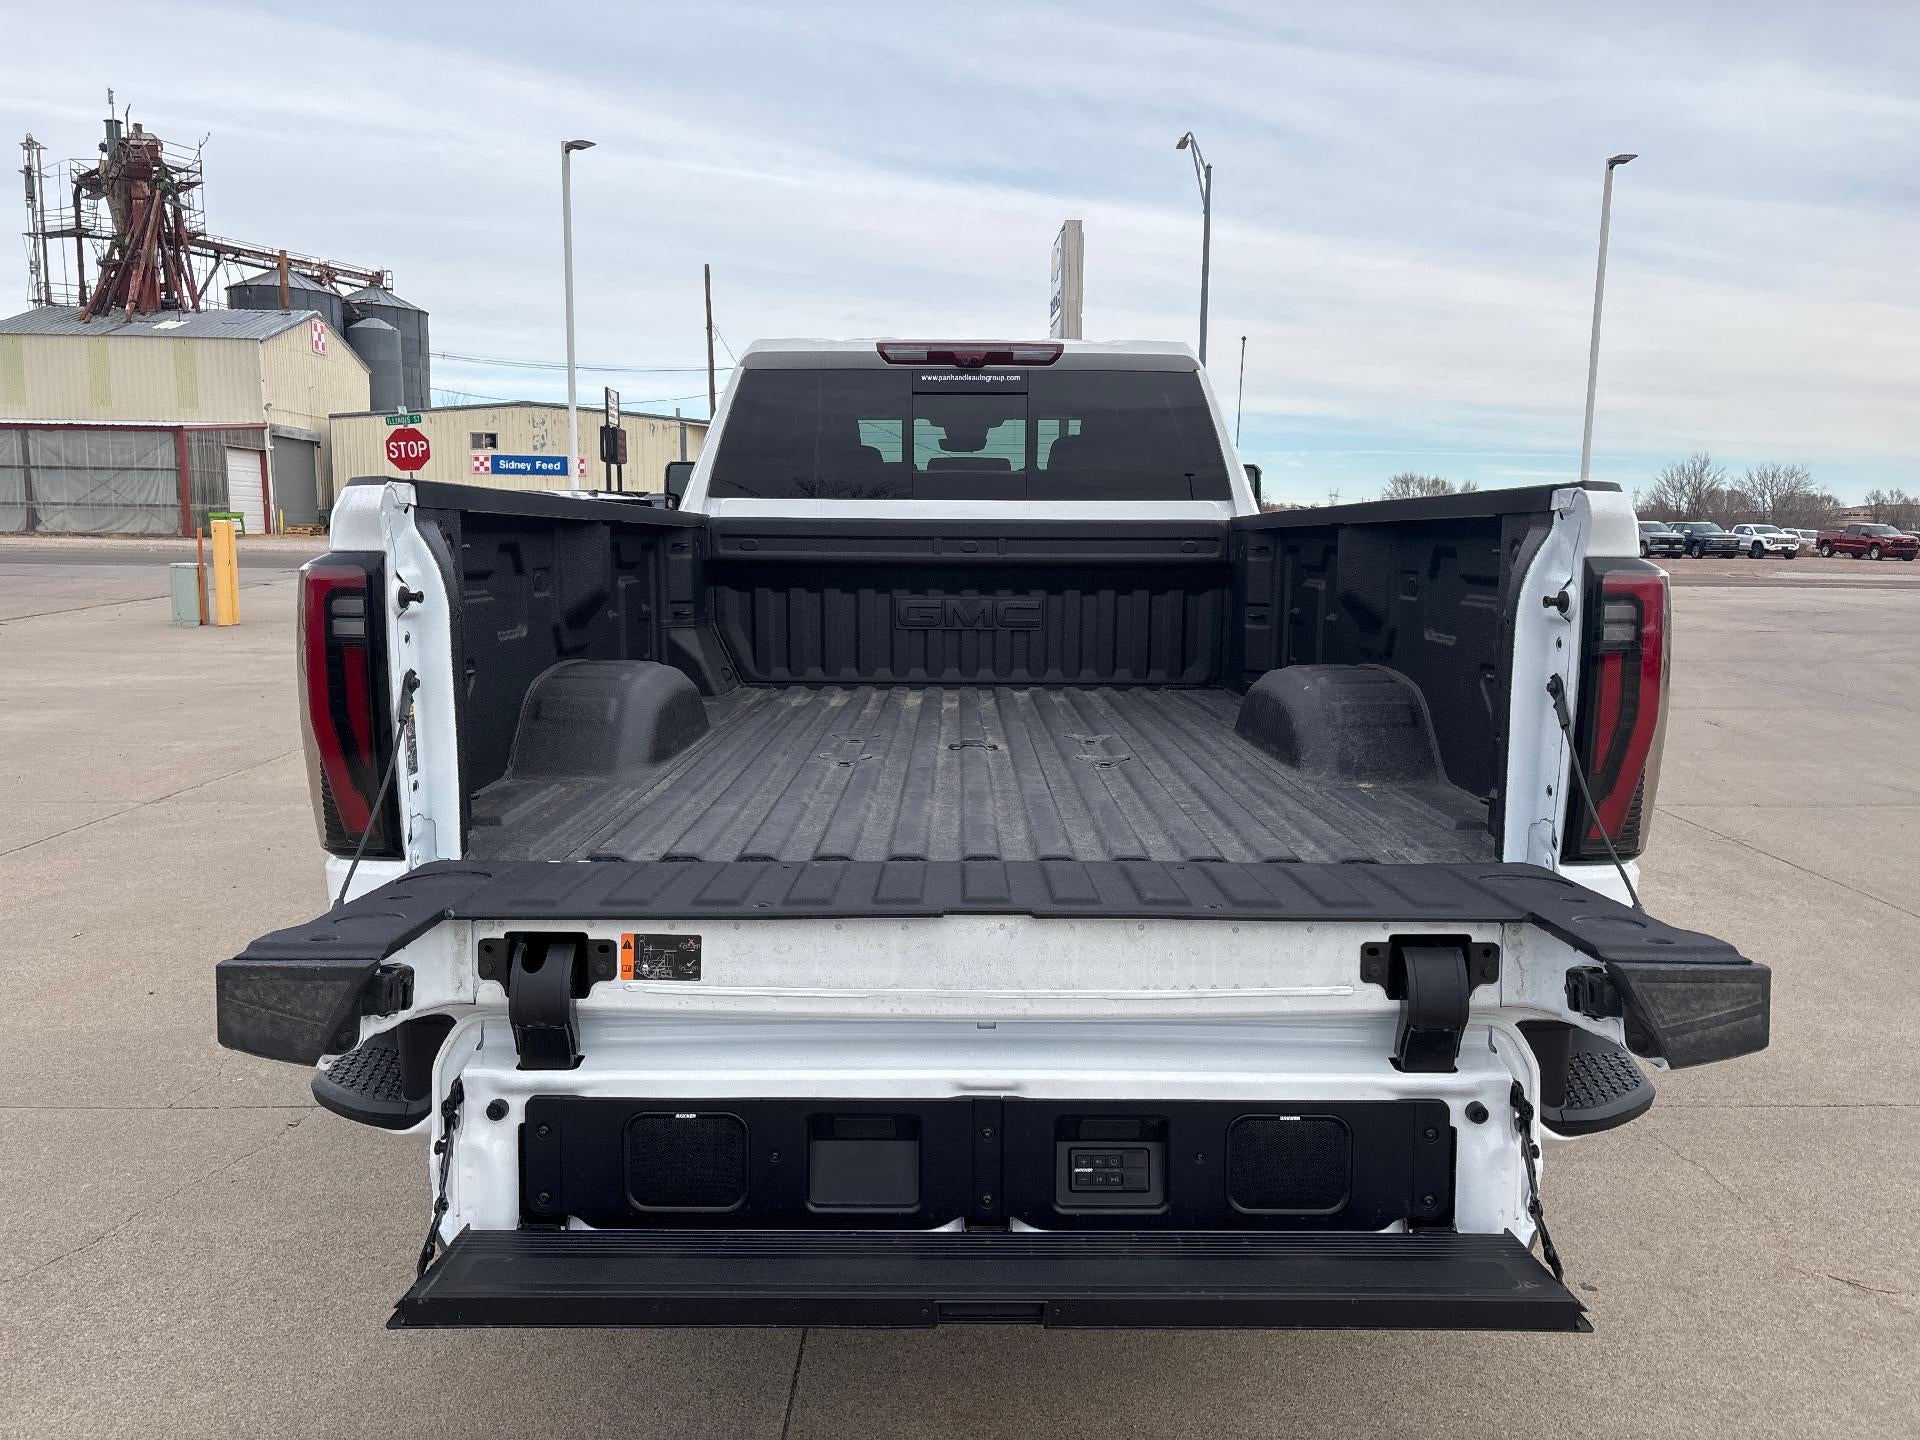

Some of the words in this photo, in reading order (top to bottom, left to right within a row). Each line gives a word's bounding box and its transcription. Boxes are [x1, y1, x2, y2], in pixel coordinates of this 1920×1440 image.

[389, 441, 427, 458] STOP
[499, 459, 531, 471] Sidney
[535, 460, 560, 470] Feed
[898, 600, 1041, 627] GMC
